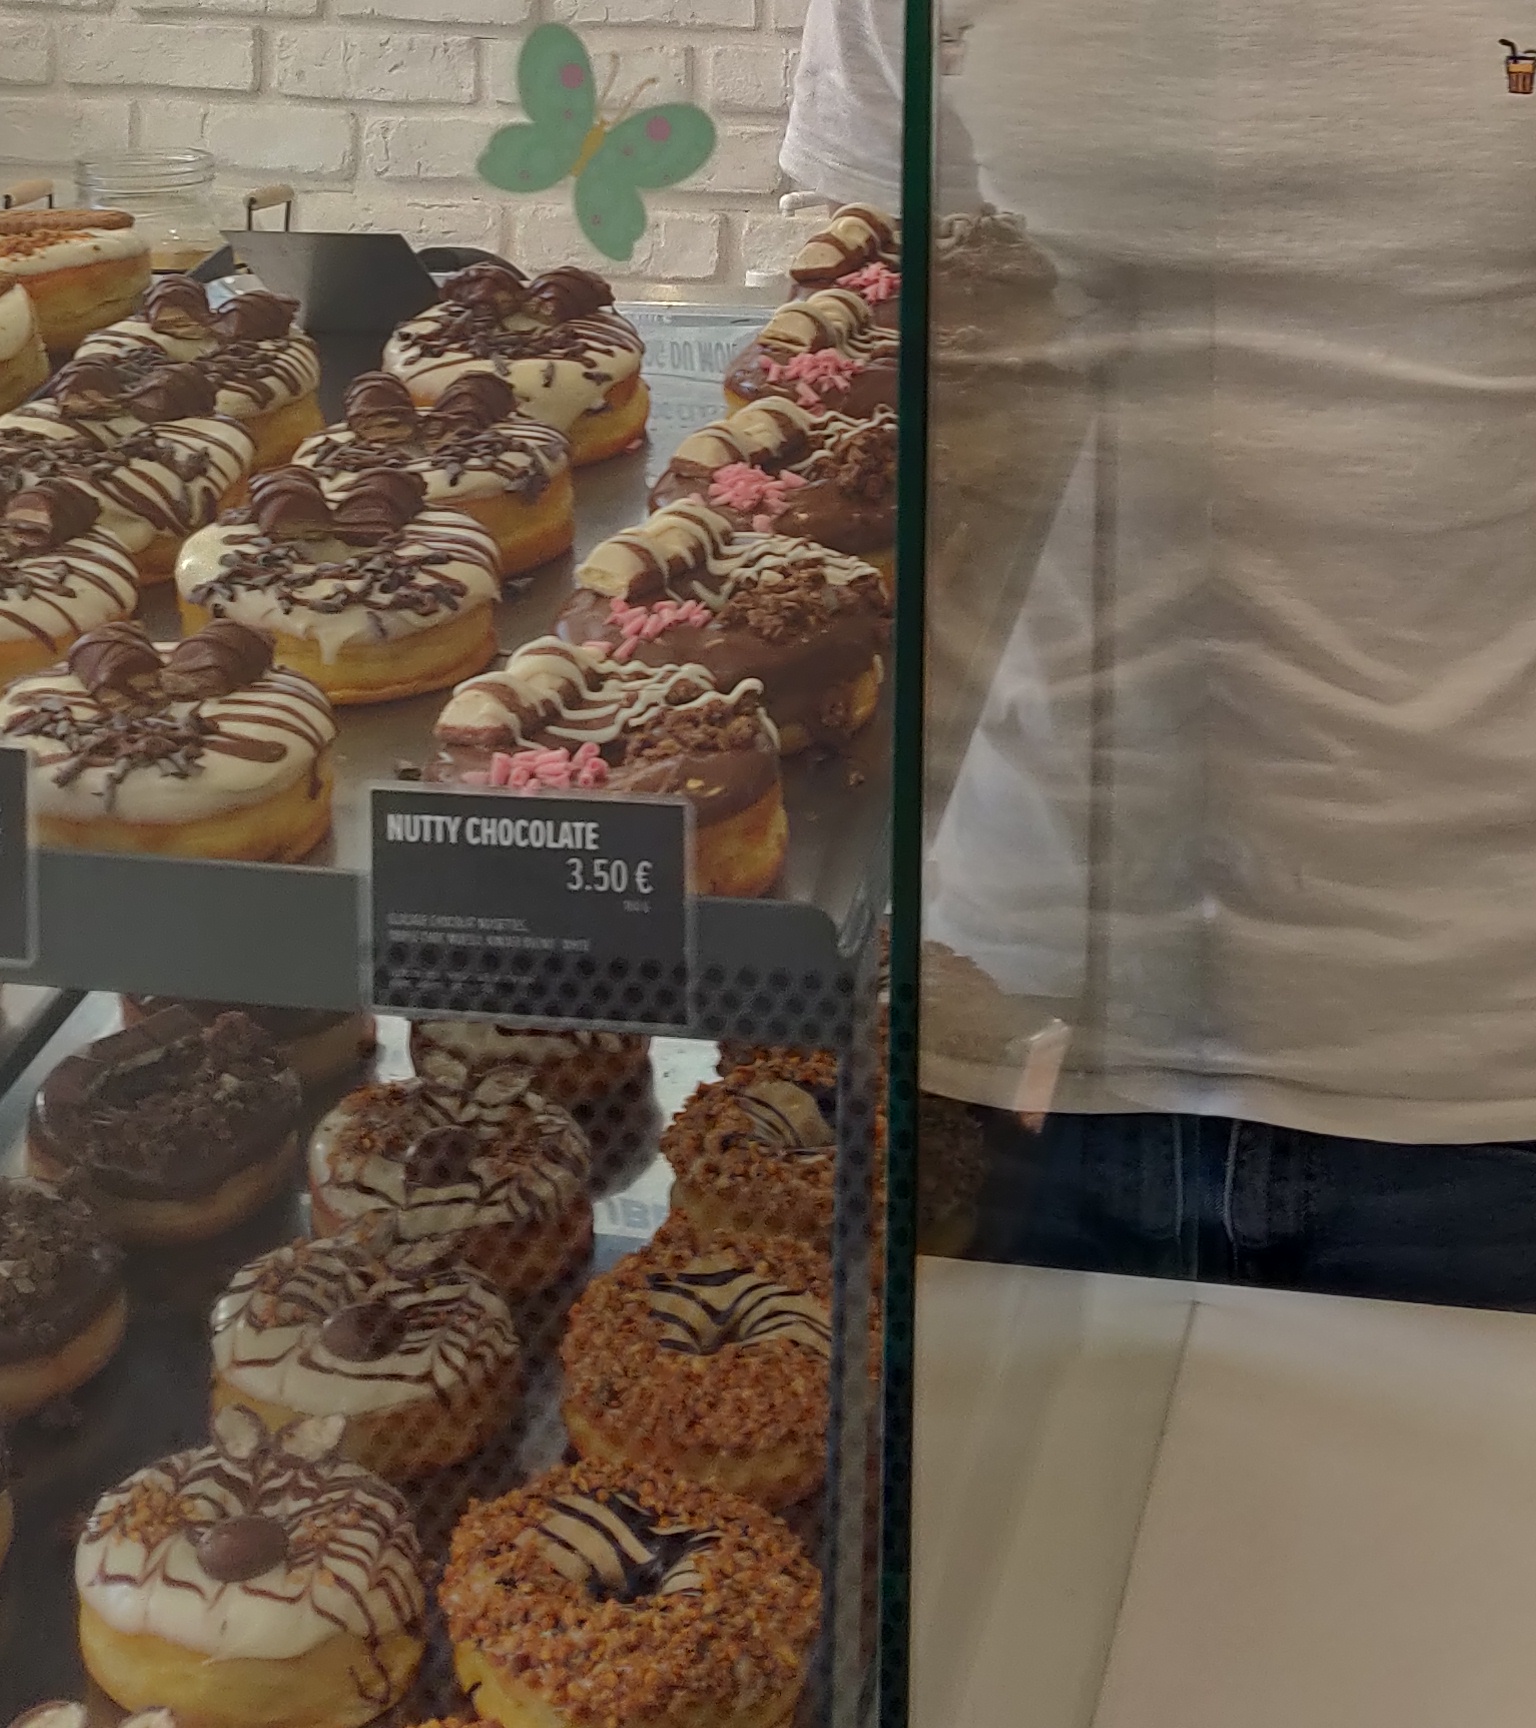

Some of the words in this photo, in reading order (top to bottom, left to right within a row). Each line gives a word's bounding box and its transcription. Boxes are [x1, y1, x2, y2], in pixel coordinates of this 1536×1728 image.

[386, 814, 462, 843] NUTTY
[465, 817, 600, 850] CHOCOLATE
[566, 858, 629, 892] 3.50
[635, 861, 653, 893] €
